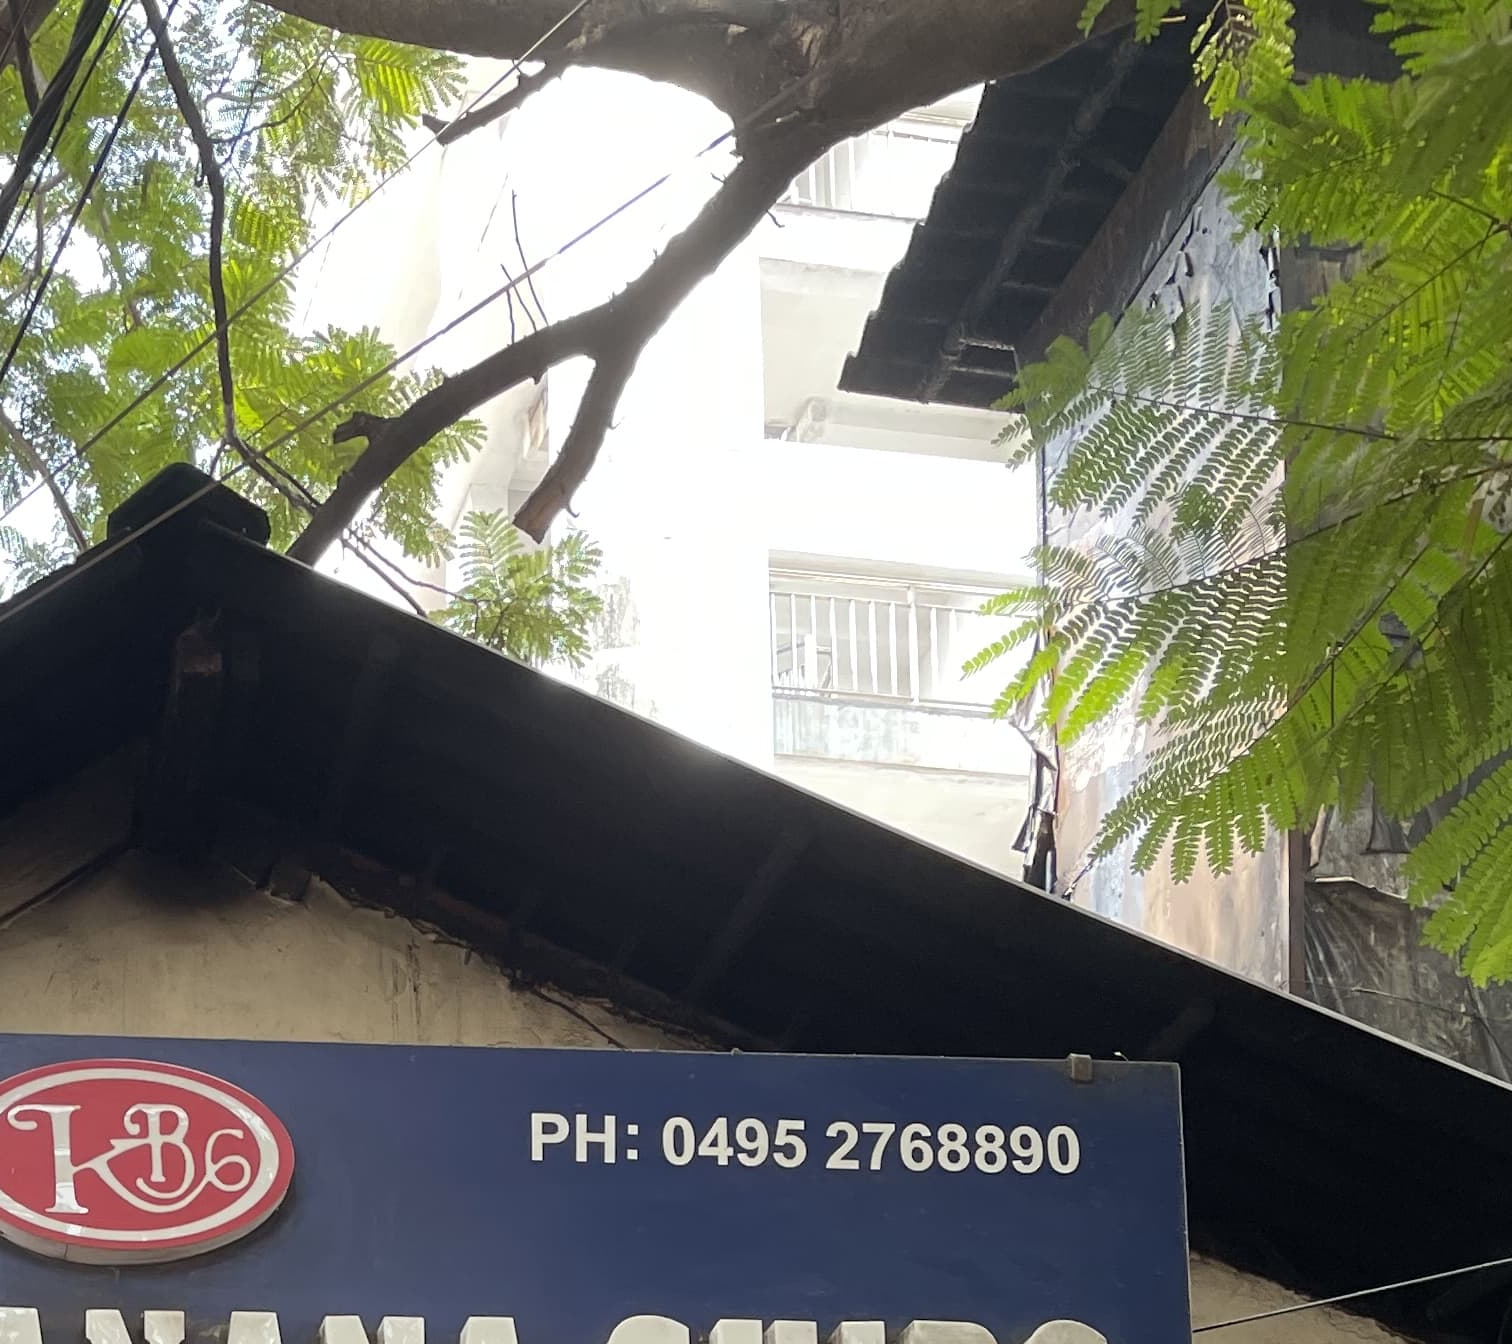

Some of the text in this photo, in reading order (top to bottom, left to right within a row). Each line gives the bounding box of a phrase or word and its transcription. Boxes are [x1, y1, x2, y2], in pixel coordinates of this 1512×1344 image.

[529, 1111, 1081, 1175] PH: 0495 2768890
